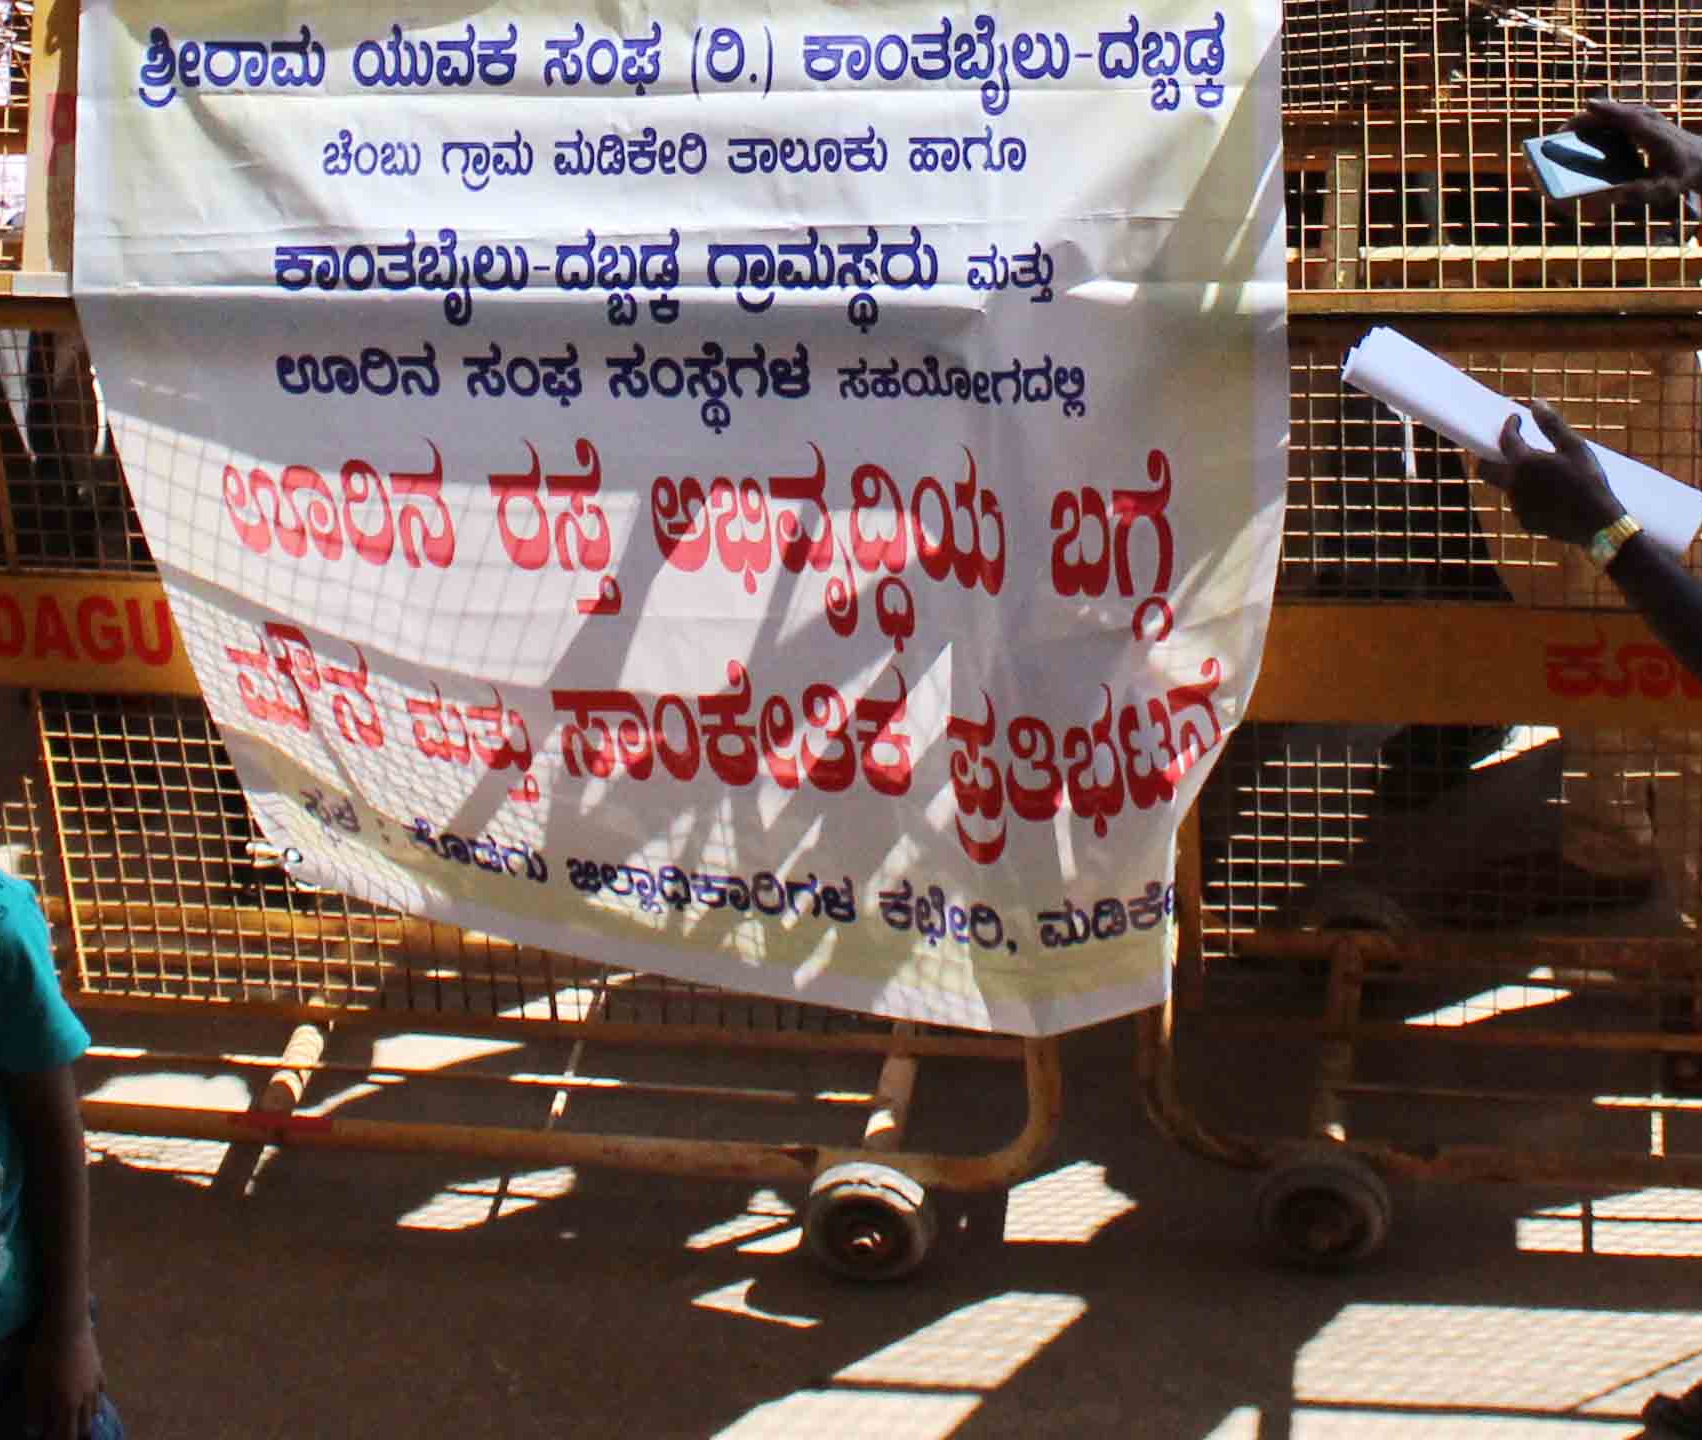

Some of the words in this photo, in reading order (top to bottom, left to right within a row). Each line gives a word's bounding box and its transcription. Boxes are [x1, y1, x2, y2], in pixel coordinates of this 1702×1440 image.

[139, 24, 326, 106] ಶ್ರೀರಾಮ
[352, 24, 517, 88] ಯುವಕ
[545, 23, 661, 98] ಸಂಘ
[692, 23, 774, 100] (ರಿ.)
[323, 129, 421, 177] ಚೆಂಬು
[442, 130, 535, 190] ಗ್ರಾಮ
[554, 125, 708, 176] ಮಡಿಕೇರಿ
[728, 127, 888, 176] ತಾಲೂಕು
[910, 126, 1028, 175] ಹಾಗೂ
[707, 227, 939, 333] ಗ್ರಾಮಸ್ಥರು
[967, 243, 1054, 304] ಮತ್ತು
[276, 341, 441, 398] ಊರಿನ
[464, 344, 583, 407] ಸಂಘ
[608, 341, 811, 433] ಸಂಸ್ಥೆಗಳ
[839, 357, 1087, 418] ಸಹಯೋಗದಲ್ಲಿ
[220, 437, 455, 570] ಊರಿನ
[489, 437, 624, 617] ರಸ್ತೆ
[650, 440, 1007, 653] ಅಭಿವೃದ್ಧಿಯ
[1050, 448, 1175, 643] ಬಗ್ಗೆ
[226, 621, 385, 749] ಮೌನ
[406, 680, 540, 804] ಮತ್ತು
[551, 658, 913, 796] ಸಾಂಕೇತಿಕ
[947, 656, 1223, 865] ಪ್ರತಿಭಟನೆ
[565, 857, 857, 923] ಜಿಲ್ಲಾಧಿಕಾರಿಗಳ
